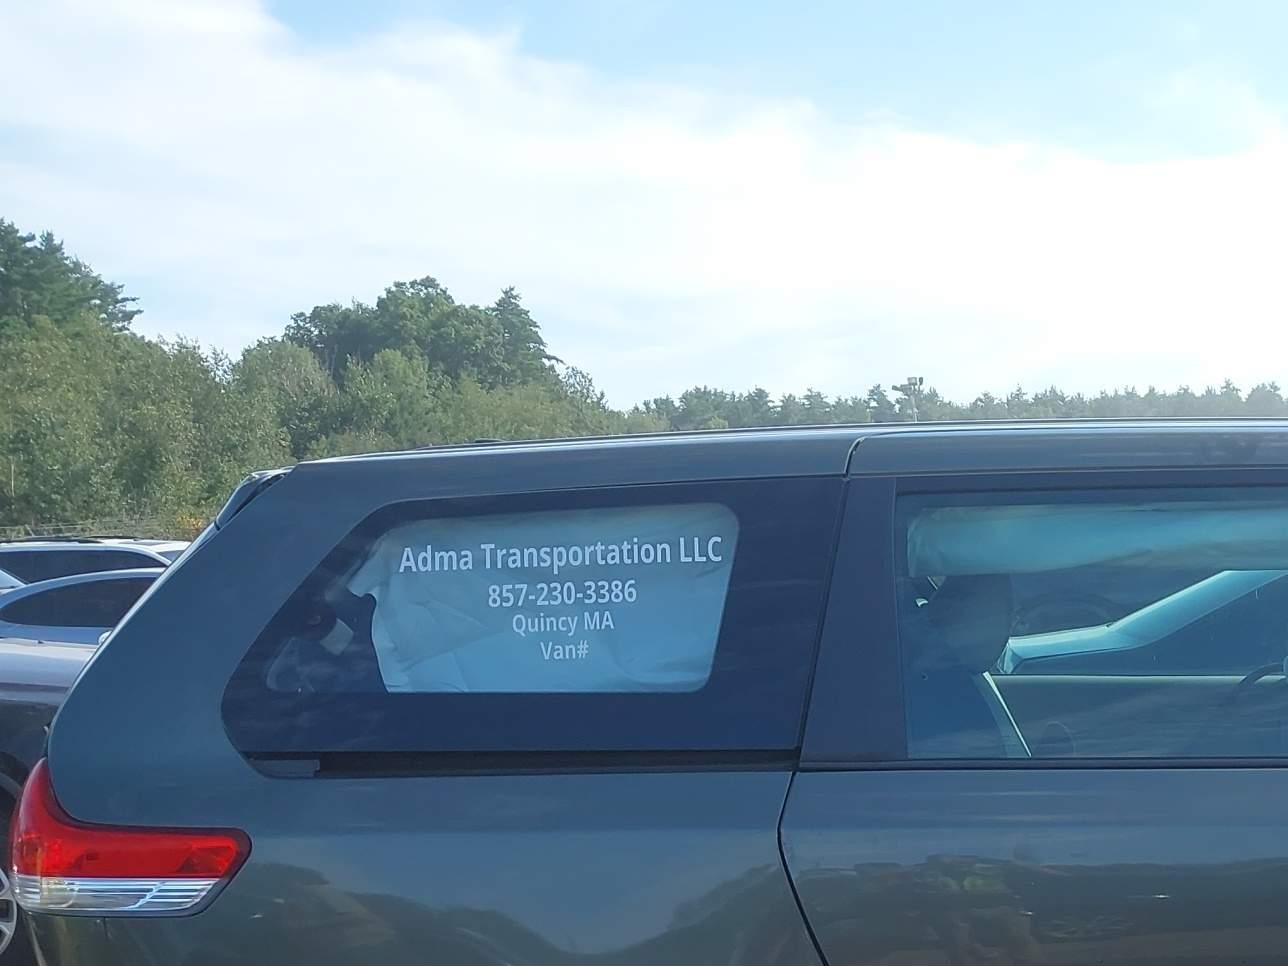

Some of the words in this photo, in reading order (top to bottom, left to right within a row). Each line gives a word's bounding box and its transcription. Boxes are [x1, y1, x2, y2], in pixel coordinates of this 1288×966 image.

[400, 545, 472, 573] Adma
[481, 538, 672, 575] Transportation
[679, 536, 723, 563] LLC
[488, 580, 637, 608] 857-230-3386
[512, 613, 579, 636] Quincy
[583, 611, 615, 630] MA
[540, 641, 589, 661] Van#
